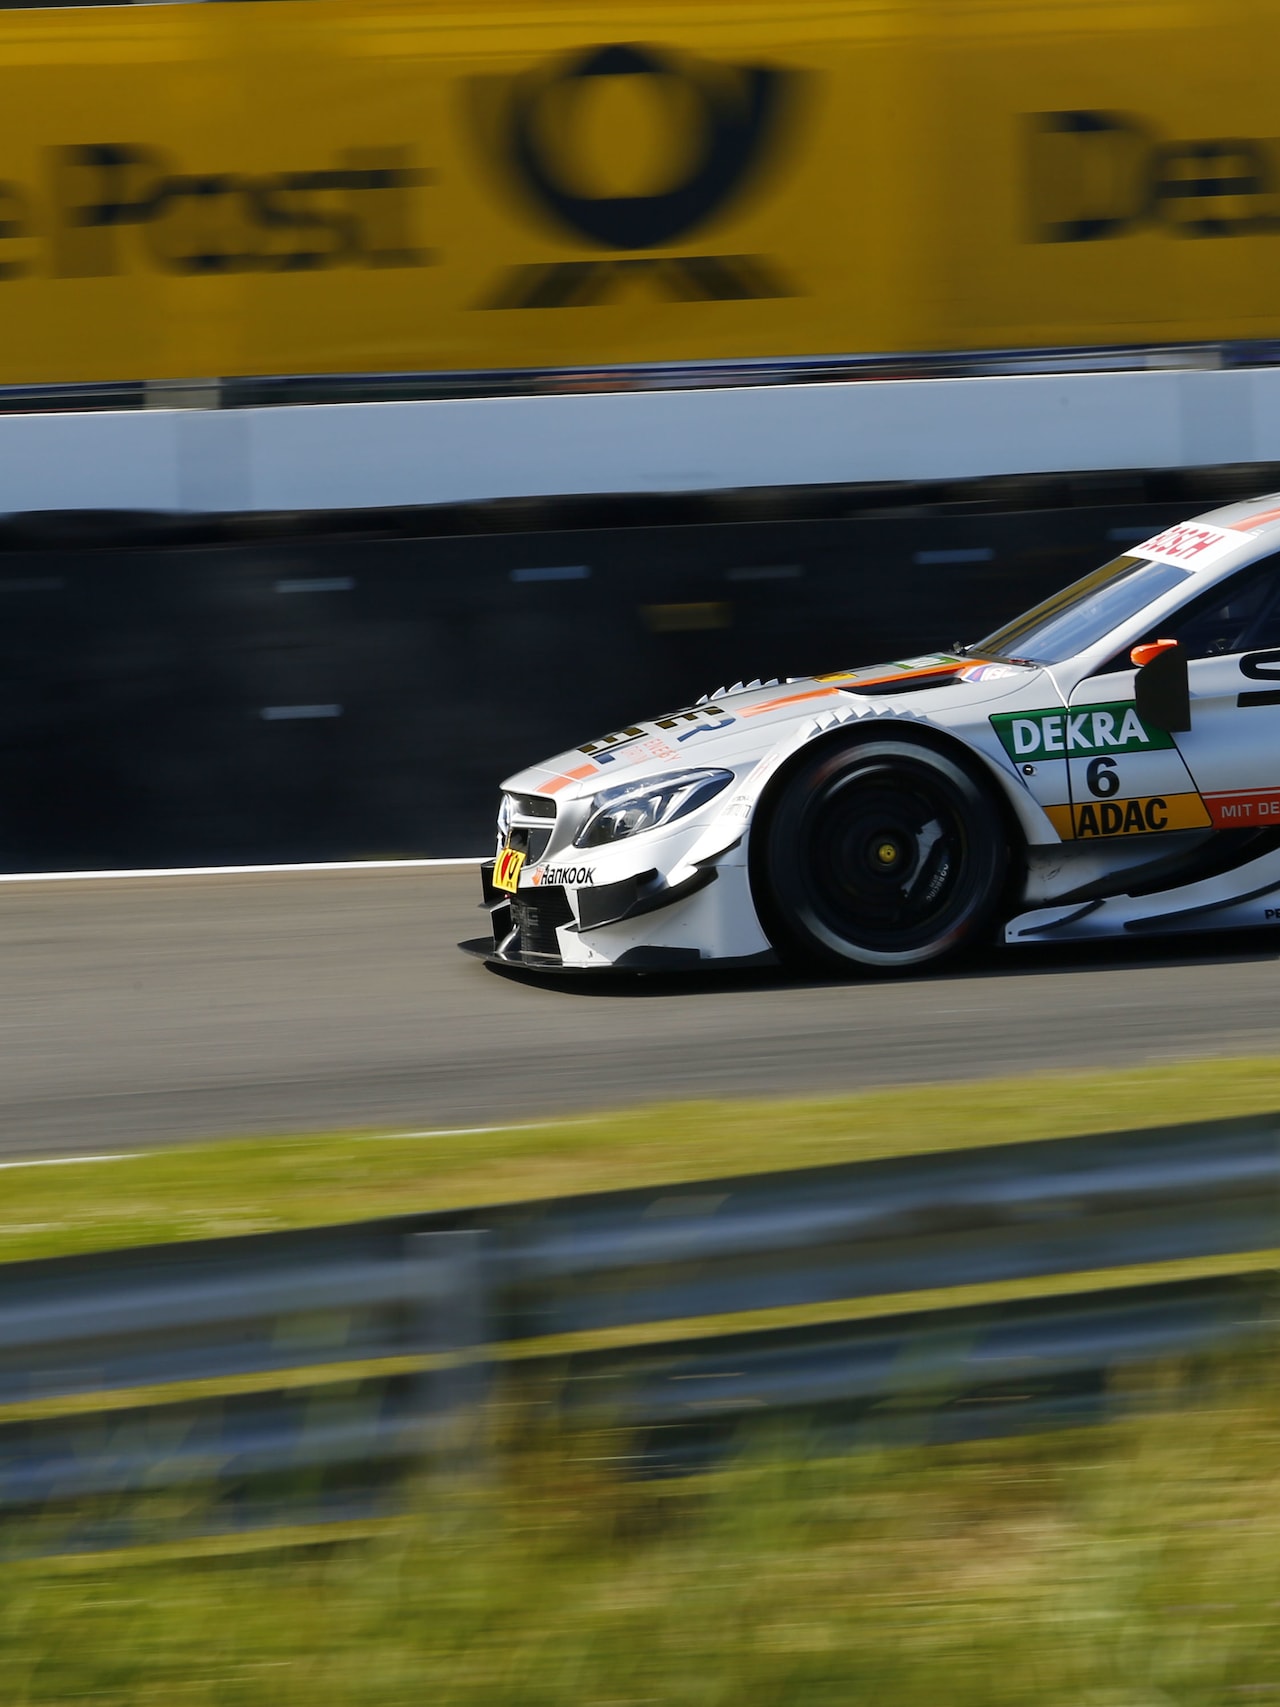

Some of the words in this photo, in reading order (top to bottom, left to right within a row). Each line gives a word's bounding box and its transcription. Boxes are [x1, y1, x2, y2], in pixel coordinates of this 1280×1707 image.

[1011, 707, 1150, 755] DEKRA
[1086, 756, 1120, 798] 6
[1077, 798, 1168, 837] ADAC
[1220, 803, 1255, 819] MIT
